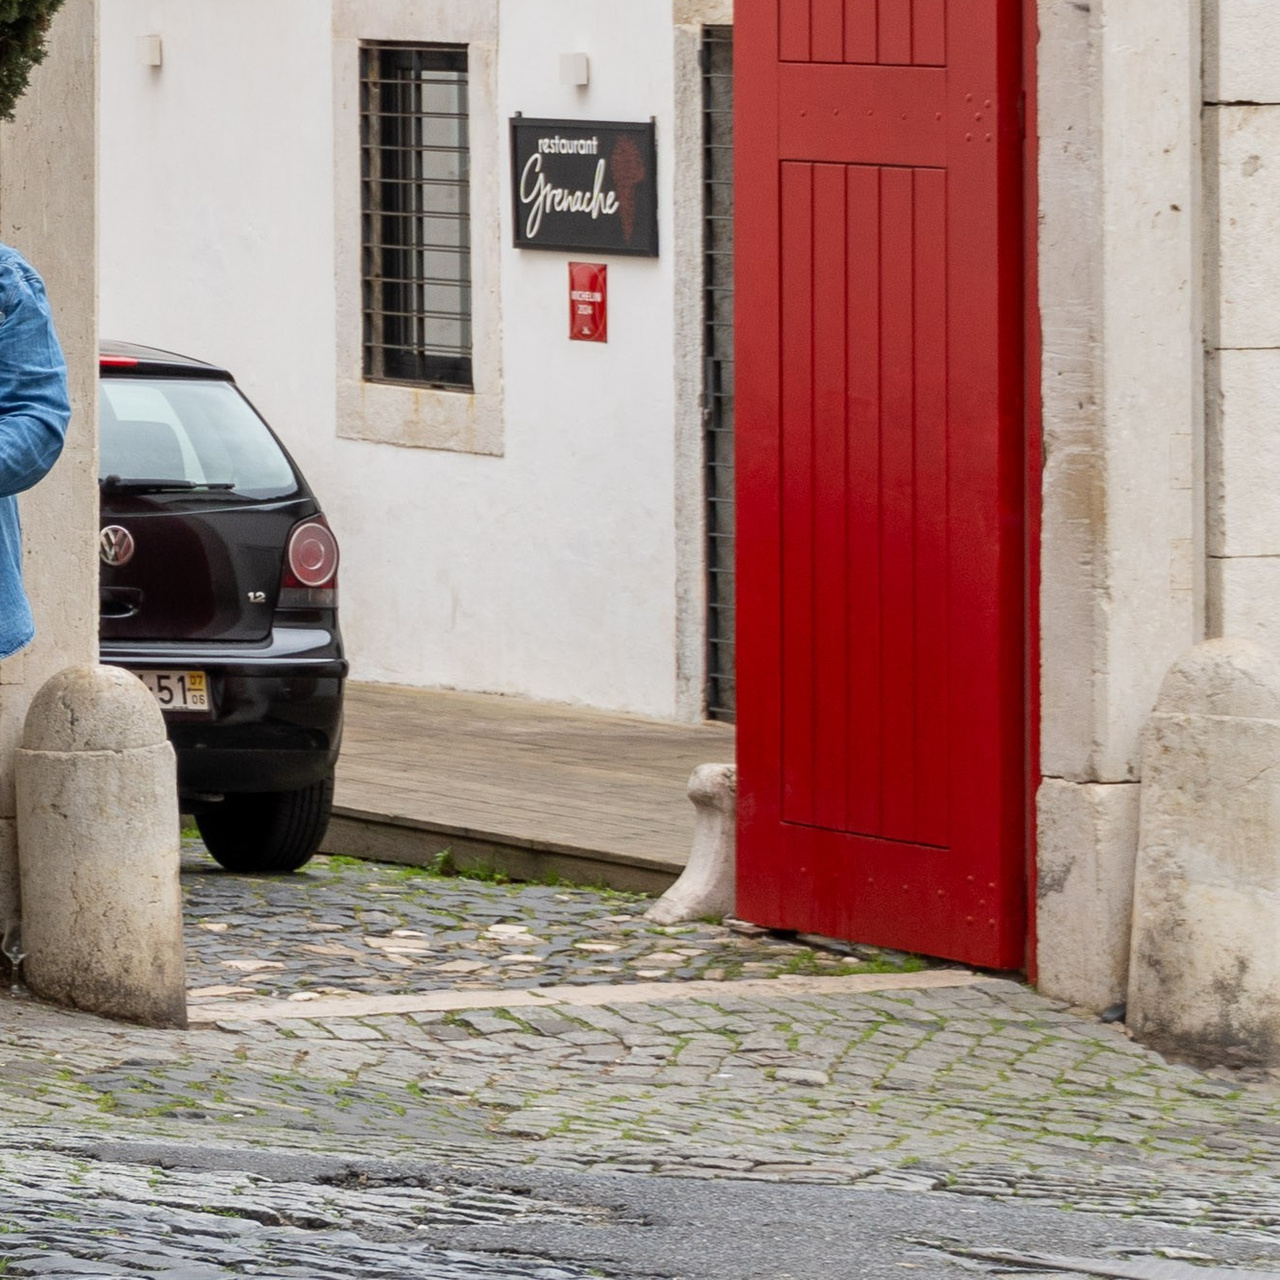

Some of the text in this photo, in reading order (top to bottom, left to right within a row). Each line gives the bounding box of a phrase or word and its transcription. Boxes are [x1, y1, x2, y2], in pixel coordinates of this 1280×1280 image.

[538, 135, 598, 155] restaurant
[520, 153, 619, 239] Grenache
[189, 674, 203, 685] 07
